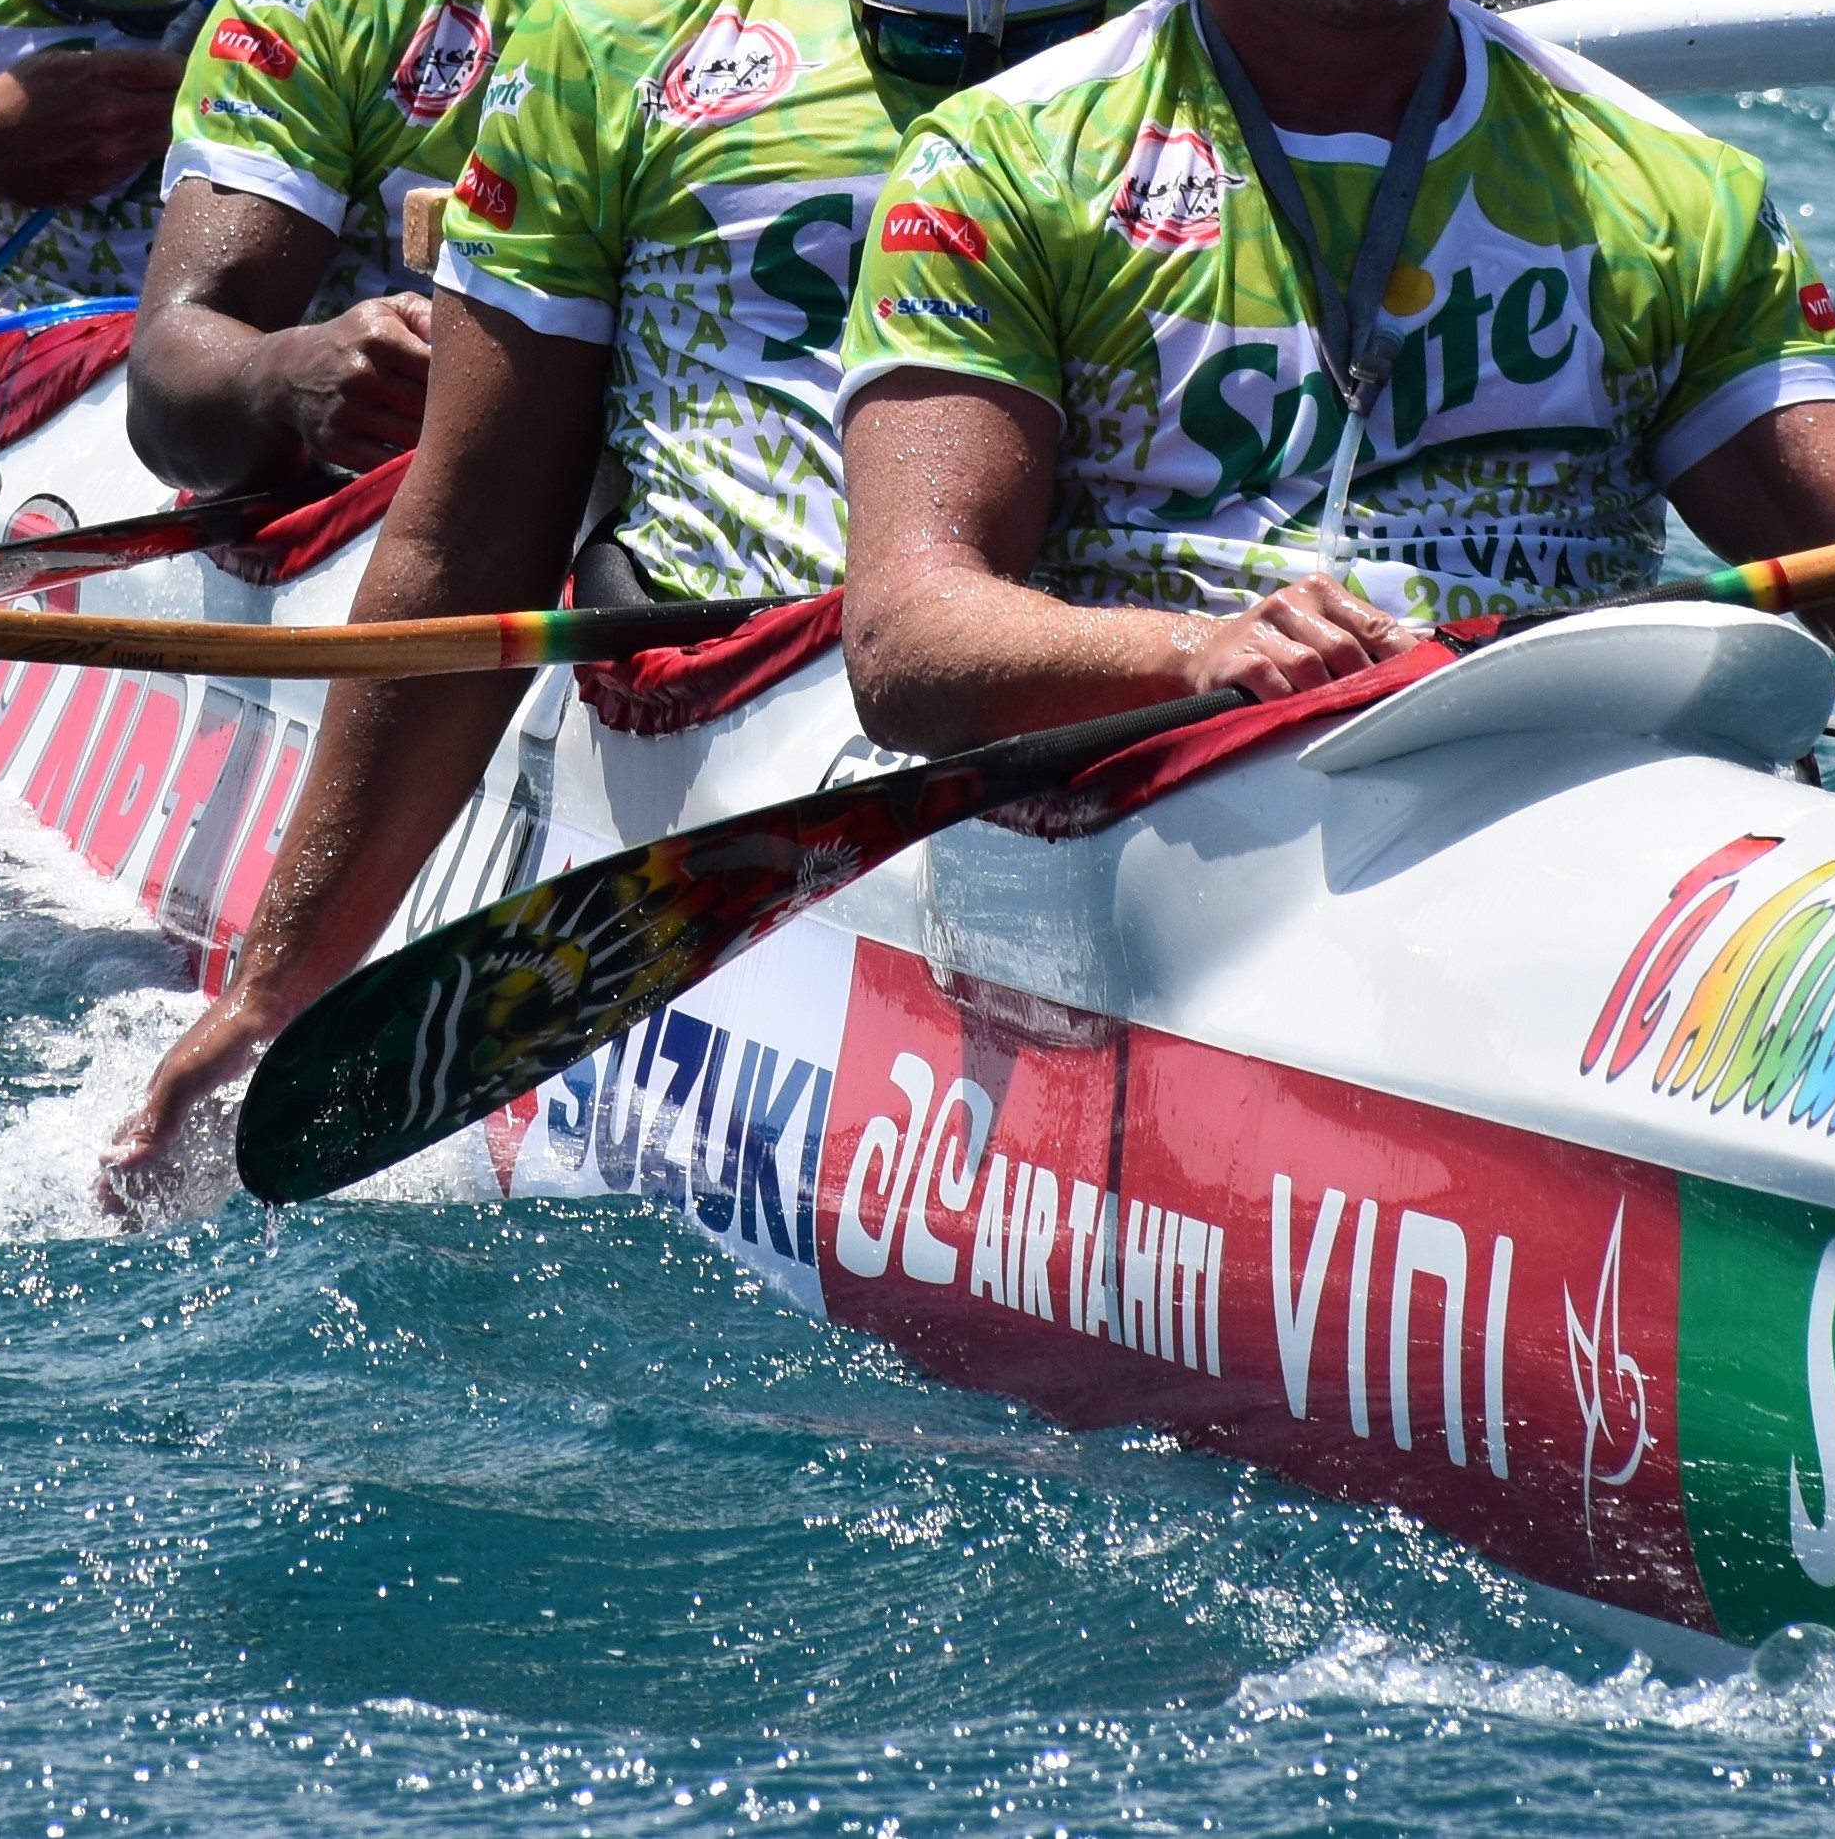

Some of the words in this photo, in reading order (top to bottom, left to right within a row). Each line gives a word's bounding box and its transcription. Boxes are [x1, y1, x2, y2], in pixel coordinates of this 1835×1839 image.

[213, 99, 284, 123] SUZUKI
[895, 297, 992, 325] SUZUKI
[1150, 263, 1577, 521] Spite
[545, 1006, 834, 1268] SUZUKI
[969, 1151, 1056, 1323] AIR
[1069, 1179, 1224, 1378] TAHITI
